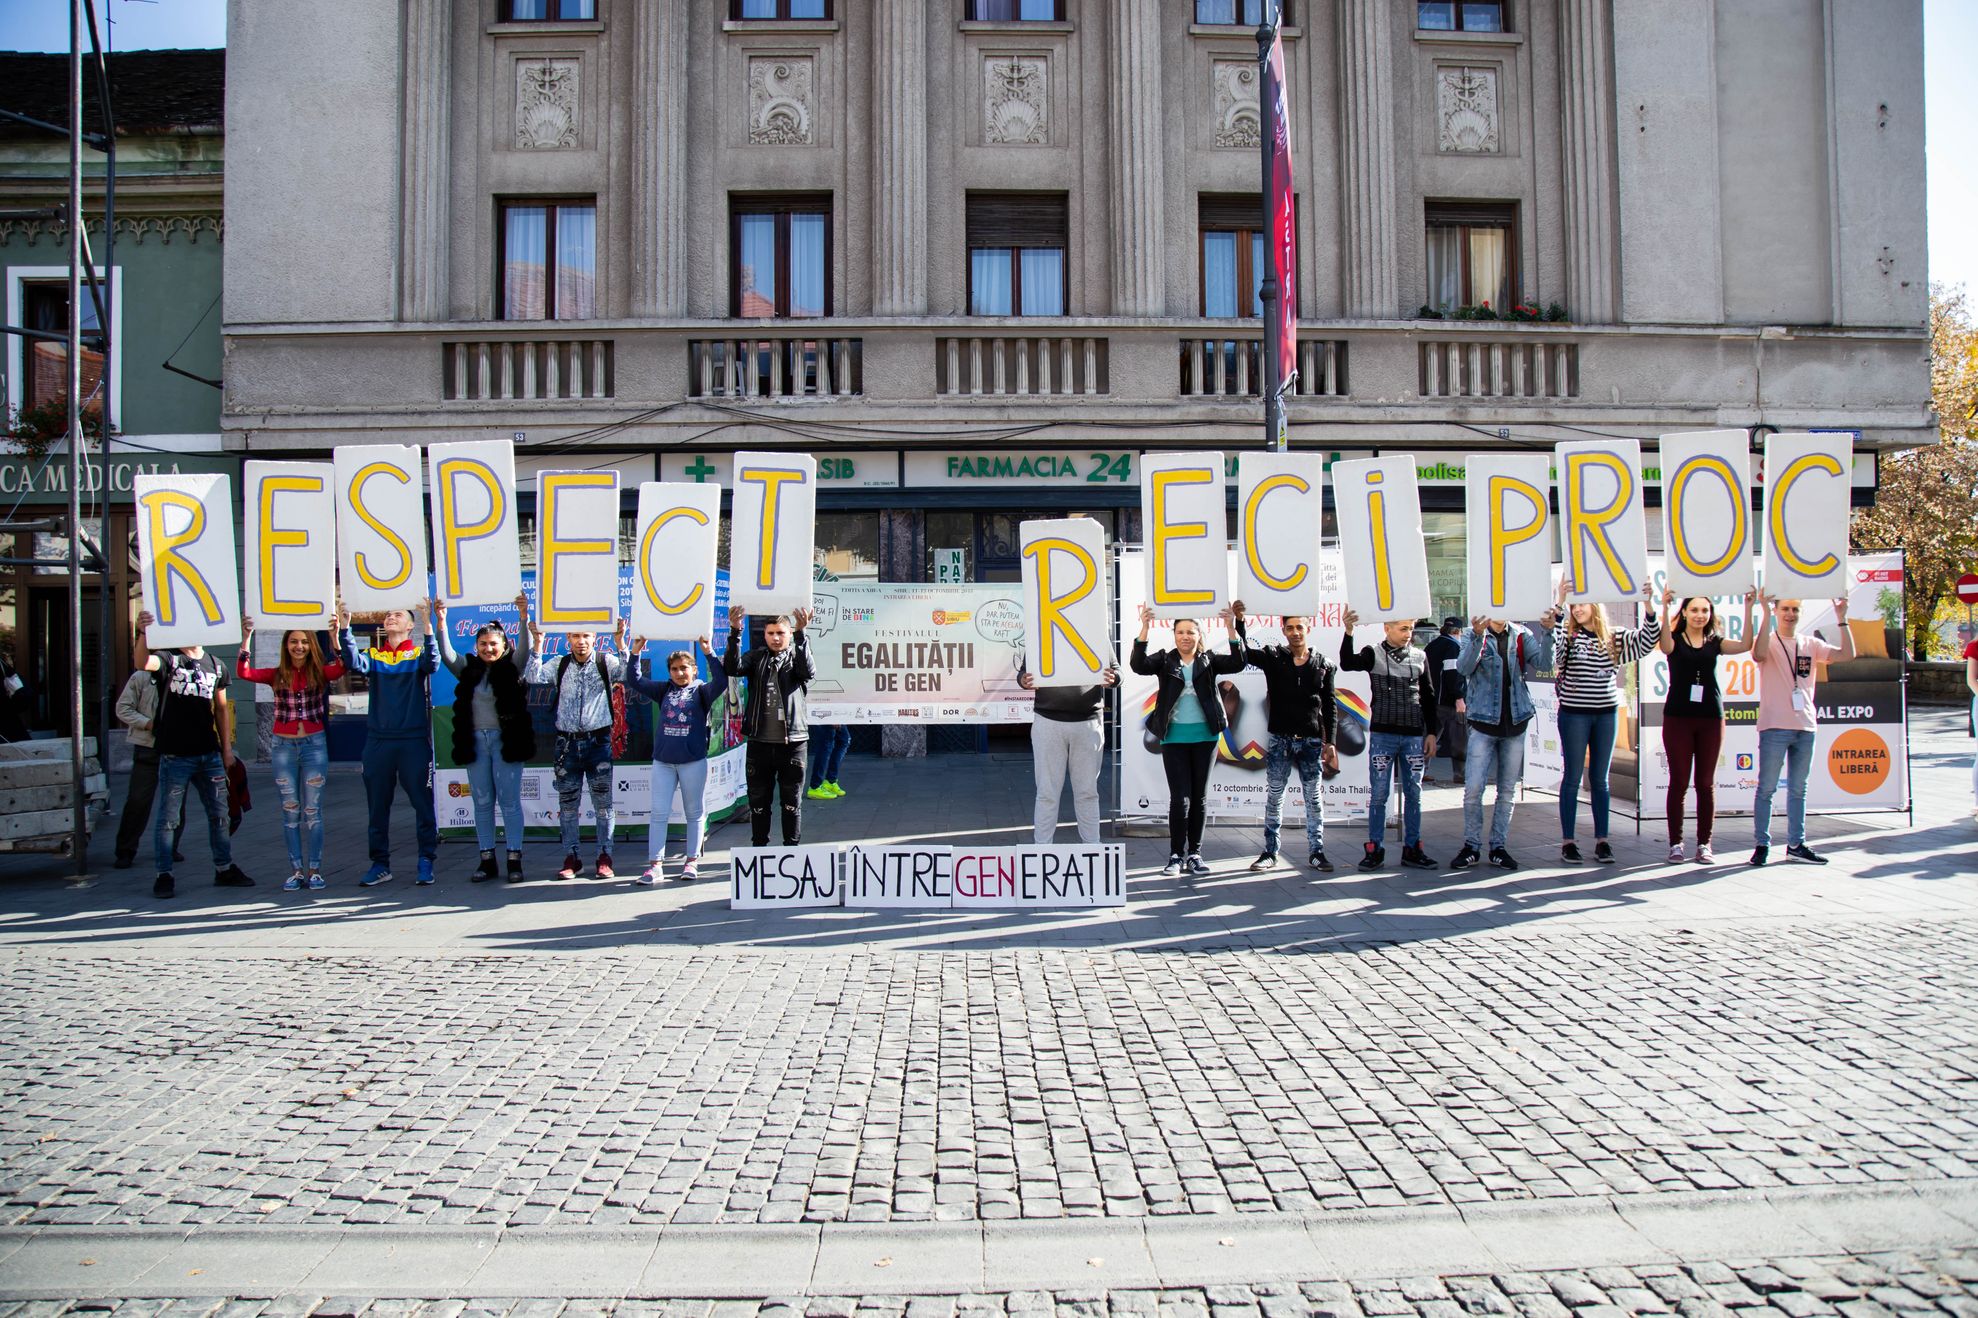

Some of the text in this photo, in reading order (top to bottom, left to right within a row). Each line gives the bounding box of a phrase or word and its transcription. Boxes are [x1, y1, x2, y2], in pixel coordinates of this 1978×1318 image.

[816, 458, 855, 480] SIB
[947, 453, 1132, 482] FARMACIA 24
[842, 606, 851, 615] ÎN
[1000, 611, 1020, 620] PUTEM
[994, 629, 1009, 637] RAFT
[841, 640, 974, 676] EGALITĂȚII
[875, 672, 942, 692] DE GEN
[1725, 660, 1756, 696] 20
[1838, 706, 1874, 719] EXPO
[1832, 749, 1886, 759] INTRAREA
[1840, 762, 1878, 774] LIBERĂ
[1212, 784, 1222, 792] 12
[1223, 784, 1264, 793] octombrie
[1329, 785, 1347, 794] Sala
[1349, 785, 1372, 794] Thalia
[450, 818, 475, 826] Hilton
[735, 852, 835, 900] MESAJ
